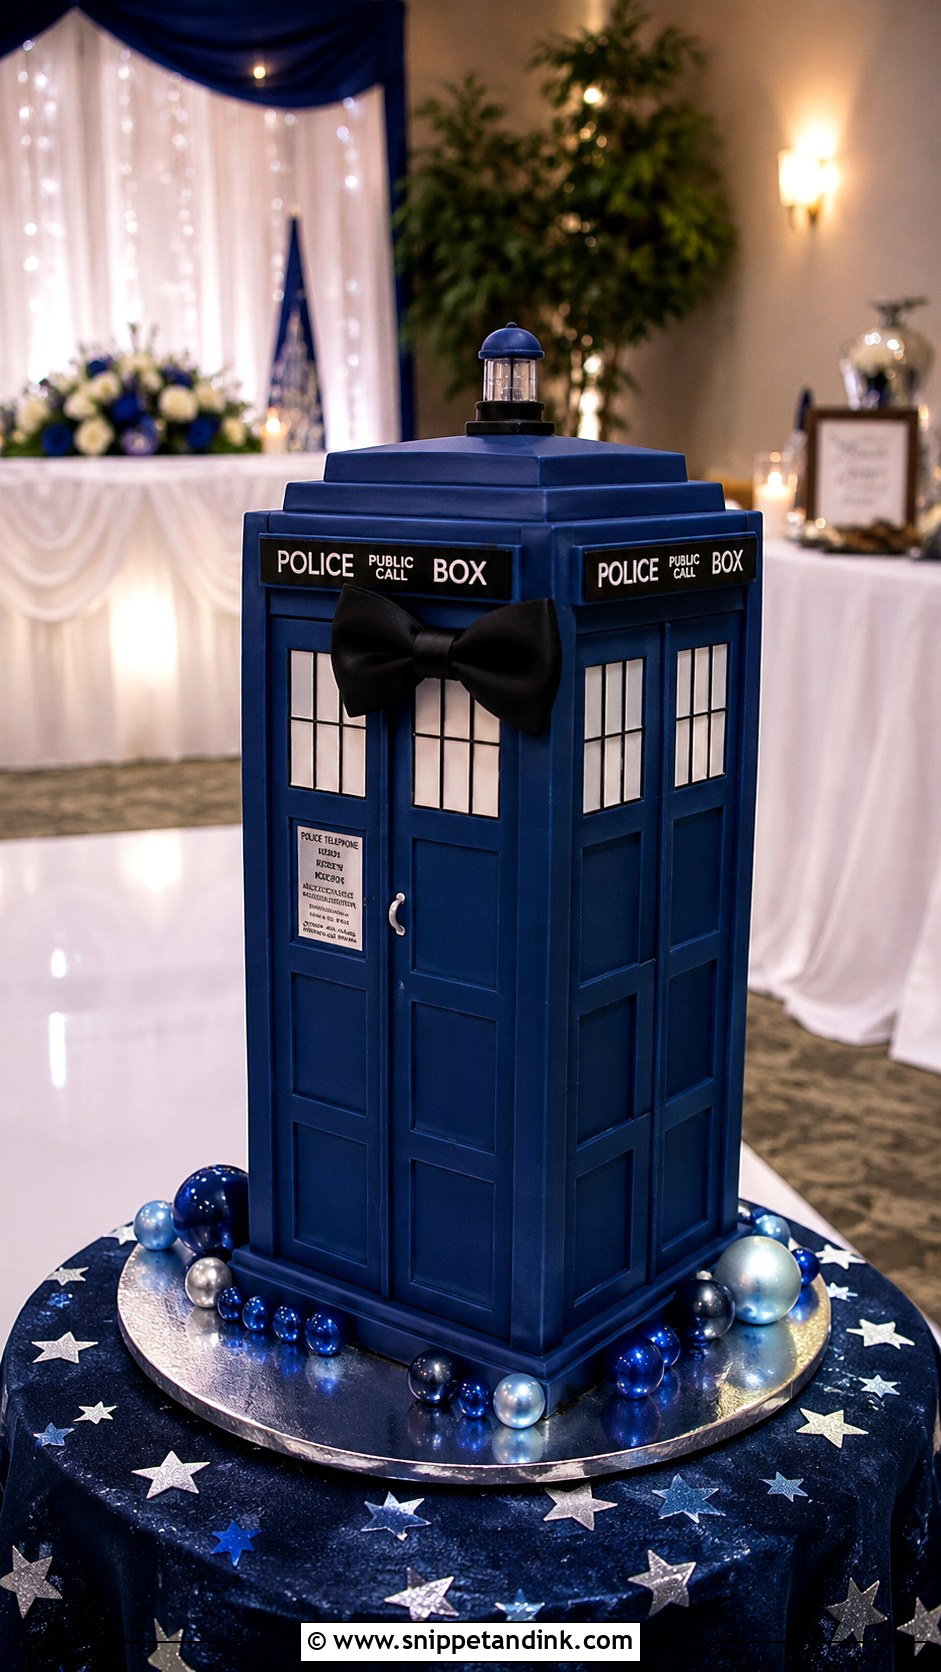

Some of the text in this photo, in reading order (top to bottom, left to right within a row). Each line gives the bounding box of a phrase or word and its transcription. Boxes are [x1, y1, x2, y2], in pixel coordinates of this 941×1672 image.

[277, 549, 488, 586] POLICE PUBLIC CALL BOX
[597, 549, 744, 588] POLICE PUBLIC CALL BOX
[300, 831, 323, 843] POLICE
